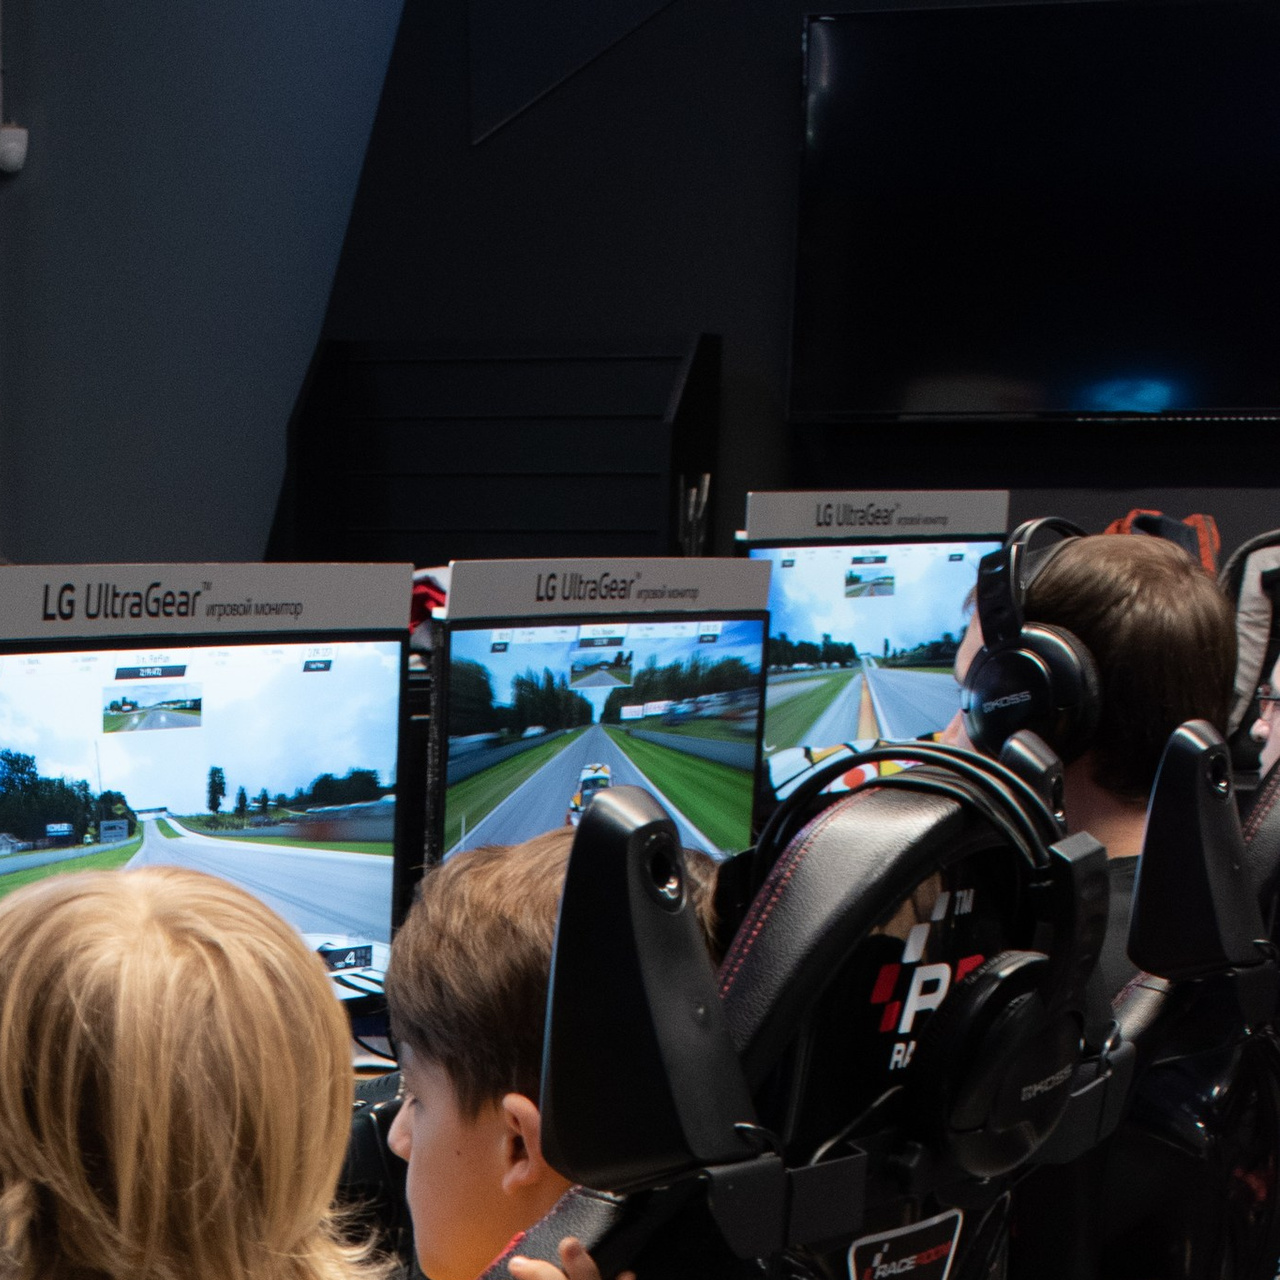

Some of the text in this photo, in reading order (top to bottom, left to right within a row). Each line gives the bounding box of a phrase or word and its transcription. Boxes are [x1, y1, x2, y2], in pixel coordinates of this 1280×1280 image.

[815, 503, 832, 526] LG
[536, 572, 558, 602] LG
[41, 582, 76, 621] LG
[205, 597, 304, 622] игровой монитор
